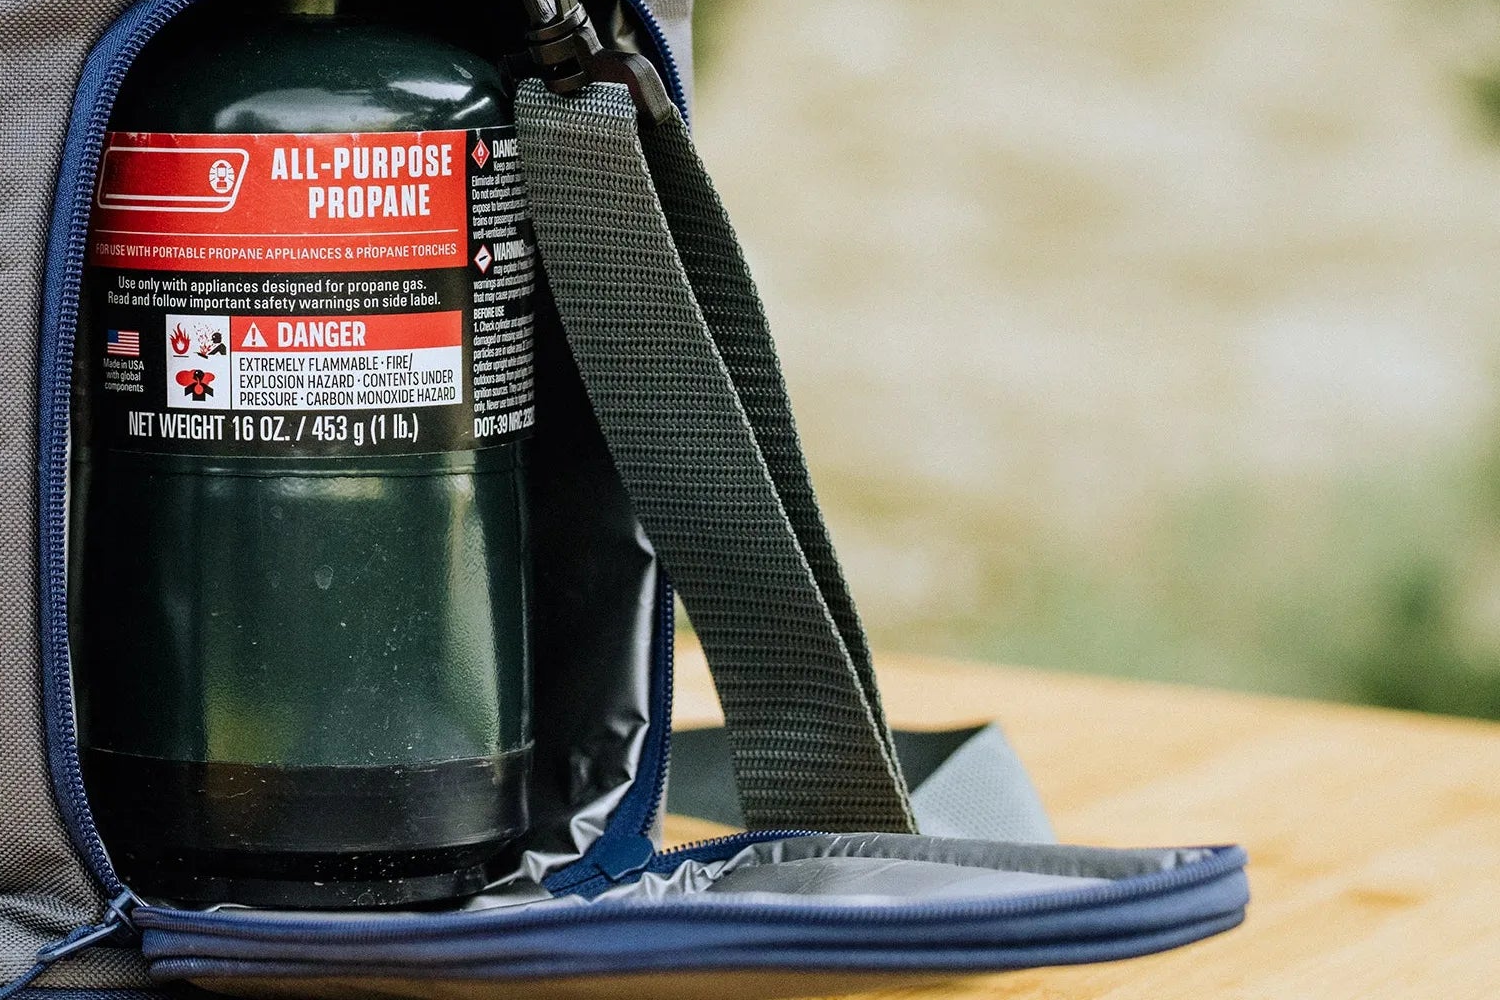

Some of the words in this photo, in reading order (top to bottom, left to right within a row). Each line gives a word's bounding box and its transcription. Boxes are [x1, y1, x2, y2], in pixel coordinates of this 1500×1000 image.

[271, 144, 452, 180] ALL-PURPOSE
[471, 175, 494, 187] Eliminate
[472, 189, 480, 200] Do
[481, 188, 489, 199] not
[308, 184, 430, 219] PROPANE
[472, 203, 491, 215] expose
[473, 215, 488, 227] trains
[110, 243, 125, 256] USE
[126, 245, 151, 257] WITH
[152, 246, 206, 259] PORTABLE
[208, 248, 263, 260] PROPANE
[265, 247, 341, 260] APPLIANCES
[345, 247, 354, 259] &
[356, 246, 409, 259] PROPANE
[411, 243, 457, 256] TORCHES
[118, 276, 136, 289] Use
[138, 278, 160, 293] only
[162, 279, 187, 291] with
[190, 279, 259, 294] appliances
[262, 279, 322, 295] designed
[325, 280, 343, 292] for
[348, 280, 400, 295] propane
[402, 279, 427, 294] gas.
[473, 277, 496, 290] warnings
[107, 291, 129, 305] Read
[131, 292, 150, 306] and
[152, 293, 187, 308] follow
[190, 295, 252, 312] important
[254, 296, 295, 312] safety
[299, 294, 360, 311] warnings
[363, 295, 379, 308] on
[382, 293, 407, 308] side
[410, 292, 441, 307] label.
[473, 291, 485, 303] that
[473, 307, 495, 320] BEFORE
[479, 320, 495, 333] Check
[277, 321, 366, 348] DANGER
[473, 333, 496, 347] damaged
[103, 358, 120, 369] Made
[121, 359, 128, 369] in
[128, 360, 144, 371] USA
[239, 357, 305, 372] EXTREMELY
[308, 356, 379, 372] FLAMMABLE
[386, 353, 413, 371] FIRE/
[106, 370, 119, 380] with
[120, 371, 141, 382] global
[239, 375, 304, 389] EXPLOSION
[307, 374, 354, 389] HAZARD
[363, 371, 419, 388] CONTENTS
[421, 369, 453, 385] UNDER
[104, 382, 143, 393] components
[239, 391, 298, 406] PRESSURE
[306, 391, 354, 406] CARBON
[357, 389, 415, 405] MONOXIDE
[417, 386, 456, 402] HAZARD
[128, 411, 154, 437] NET
[158, 413, 225, 440] WEIGHT
[232, 415, 254, 441] 16
[259, 416, 290, 441] OZ.
[296, 415, 306, 441] /
[311, 415, 348, 441] 453
[353, 421, 364, 446] g
[370, 414, 386, 444] (1
[393, 413, 419, 443] lb.)
[474, 413, 509, 438] DOT-39
